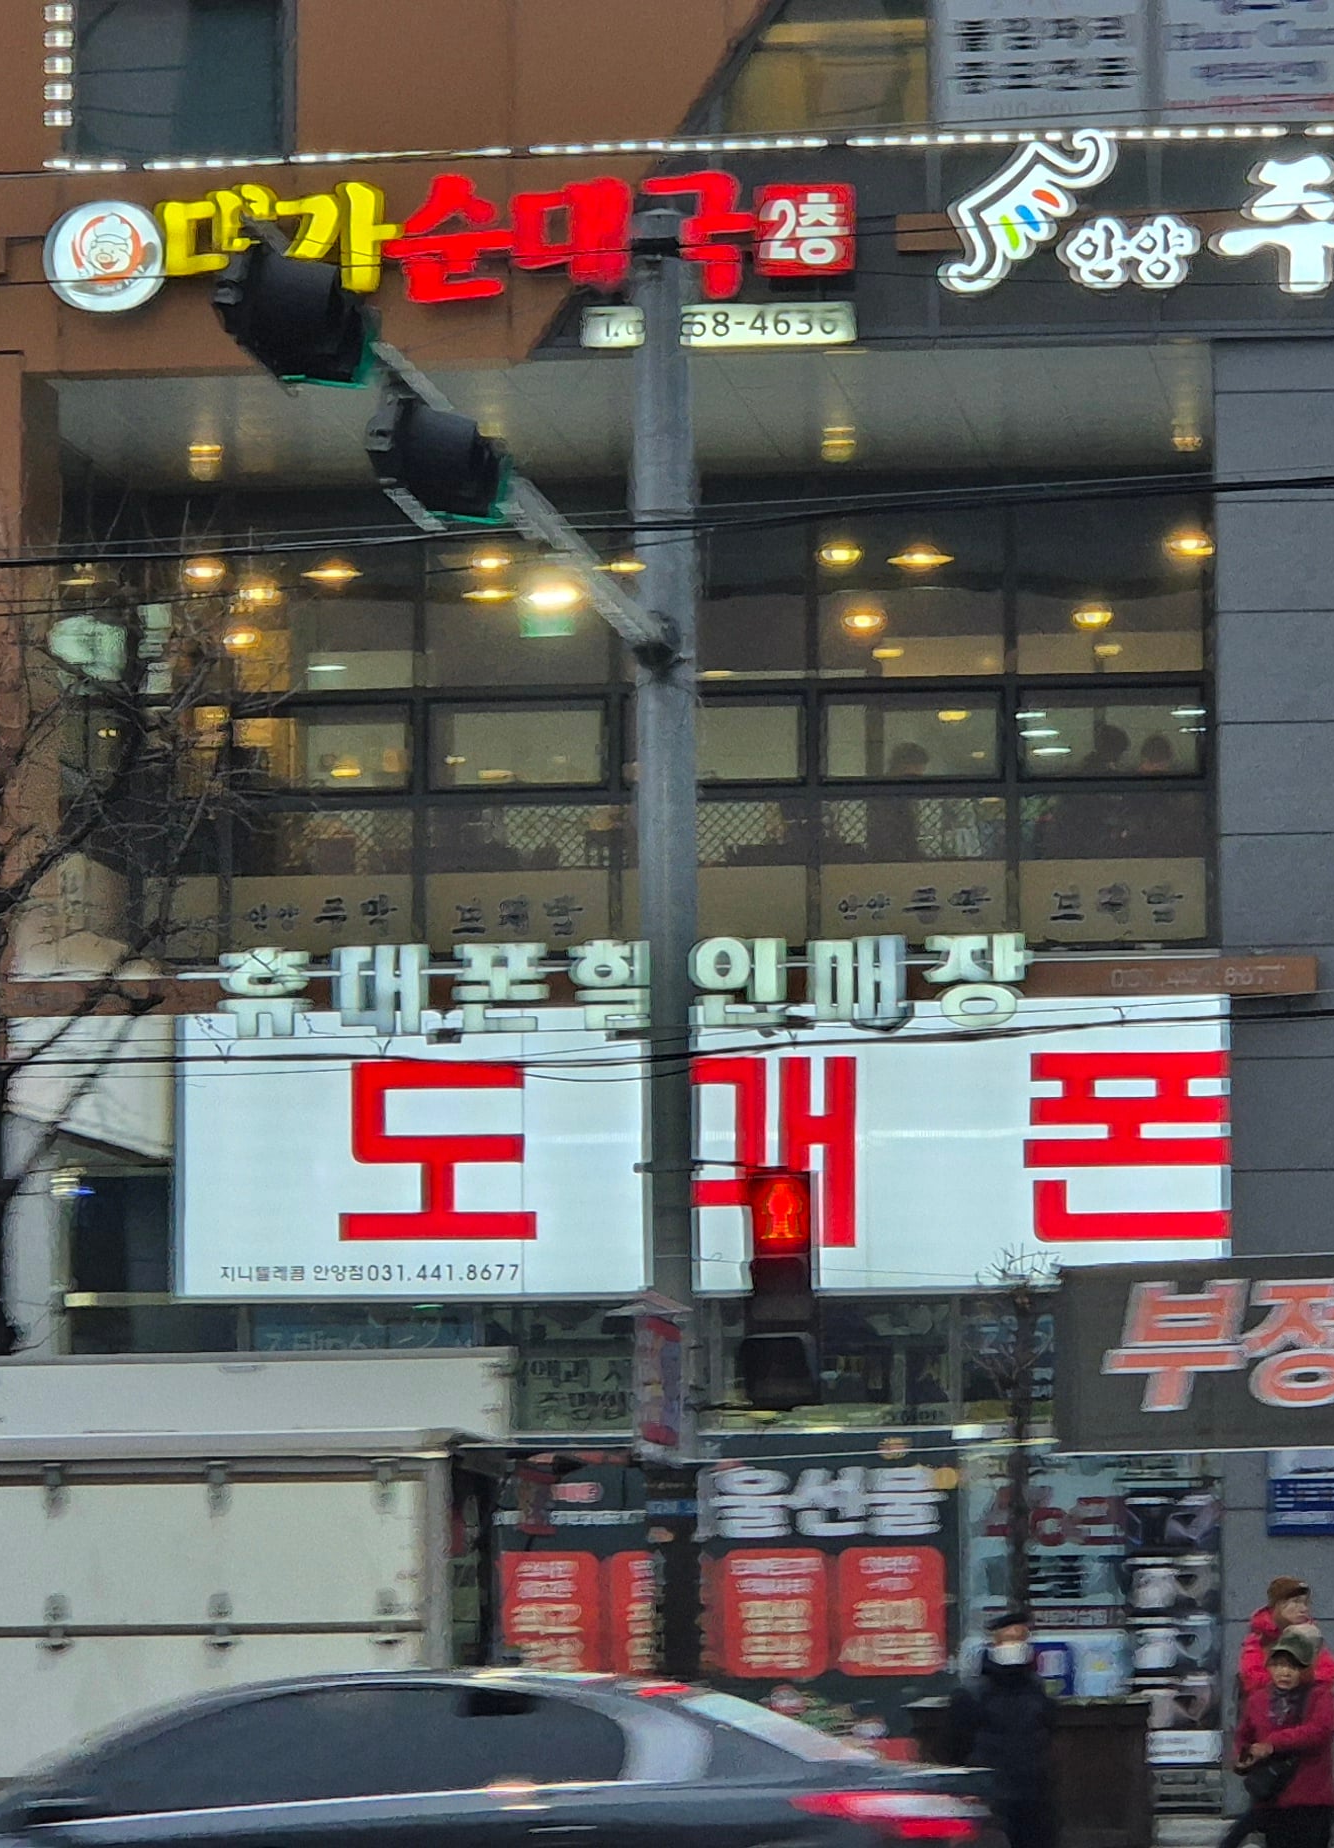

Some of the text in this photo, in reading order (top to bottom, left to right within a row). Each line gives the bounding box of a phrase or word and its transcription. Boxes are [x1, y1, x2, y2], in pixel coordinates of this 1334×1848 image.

[757, 192, 852, 264] 2층
[215, 932, 1035, 1038] 휴대폰할인매장
[220, 1263, 521, 1283] 지니텔레콤 안양점 031.441.8677
